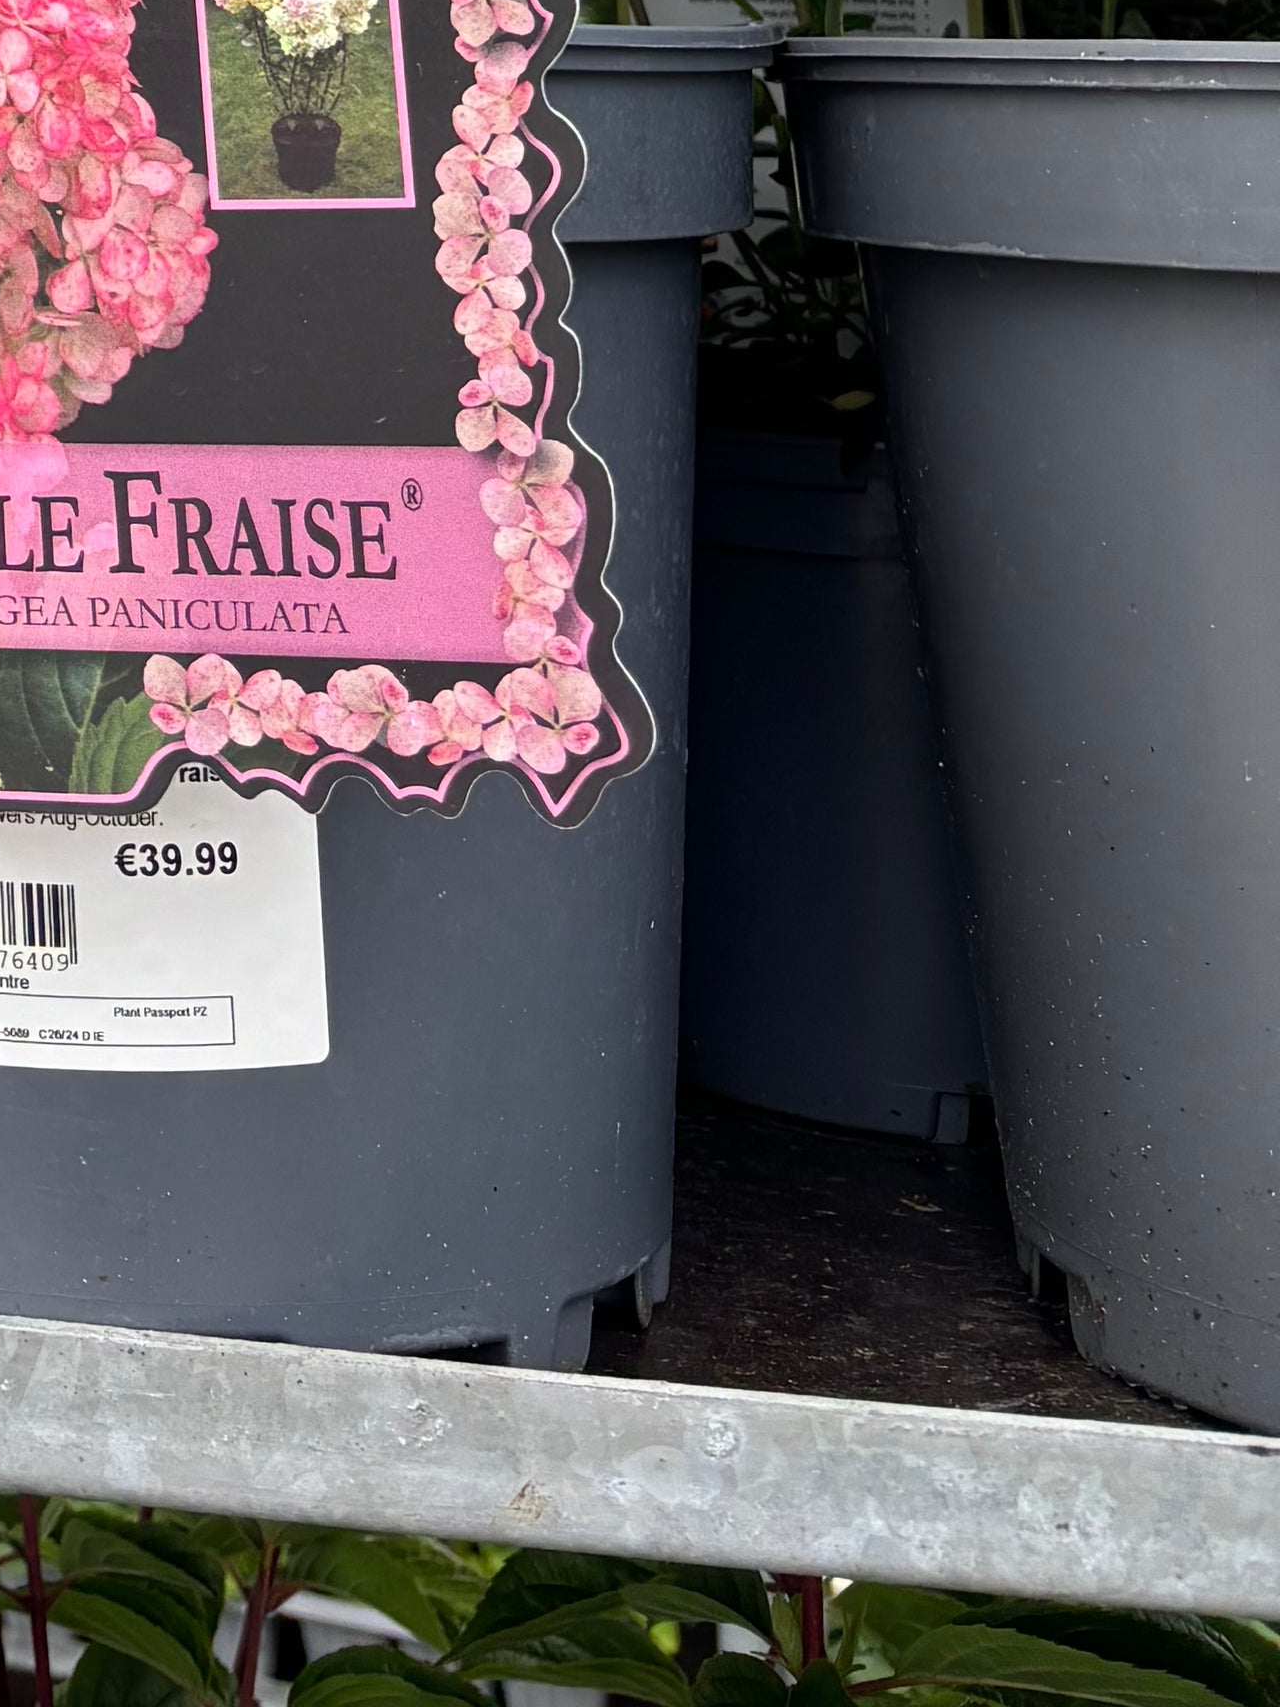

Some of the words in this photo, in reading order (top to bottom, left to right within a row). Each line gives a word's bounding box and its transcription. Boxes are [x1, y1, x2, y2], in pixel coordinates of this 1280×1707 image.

[89, 595, 351, 634] PANICULATA
[114, 841, 239, 877] €39.99
[113, 1006, 141, 1017] Plant
[144, 1007, 191, 1019] Passport
